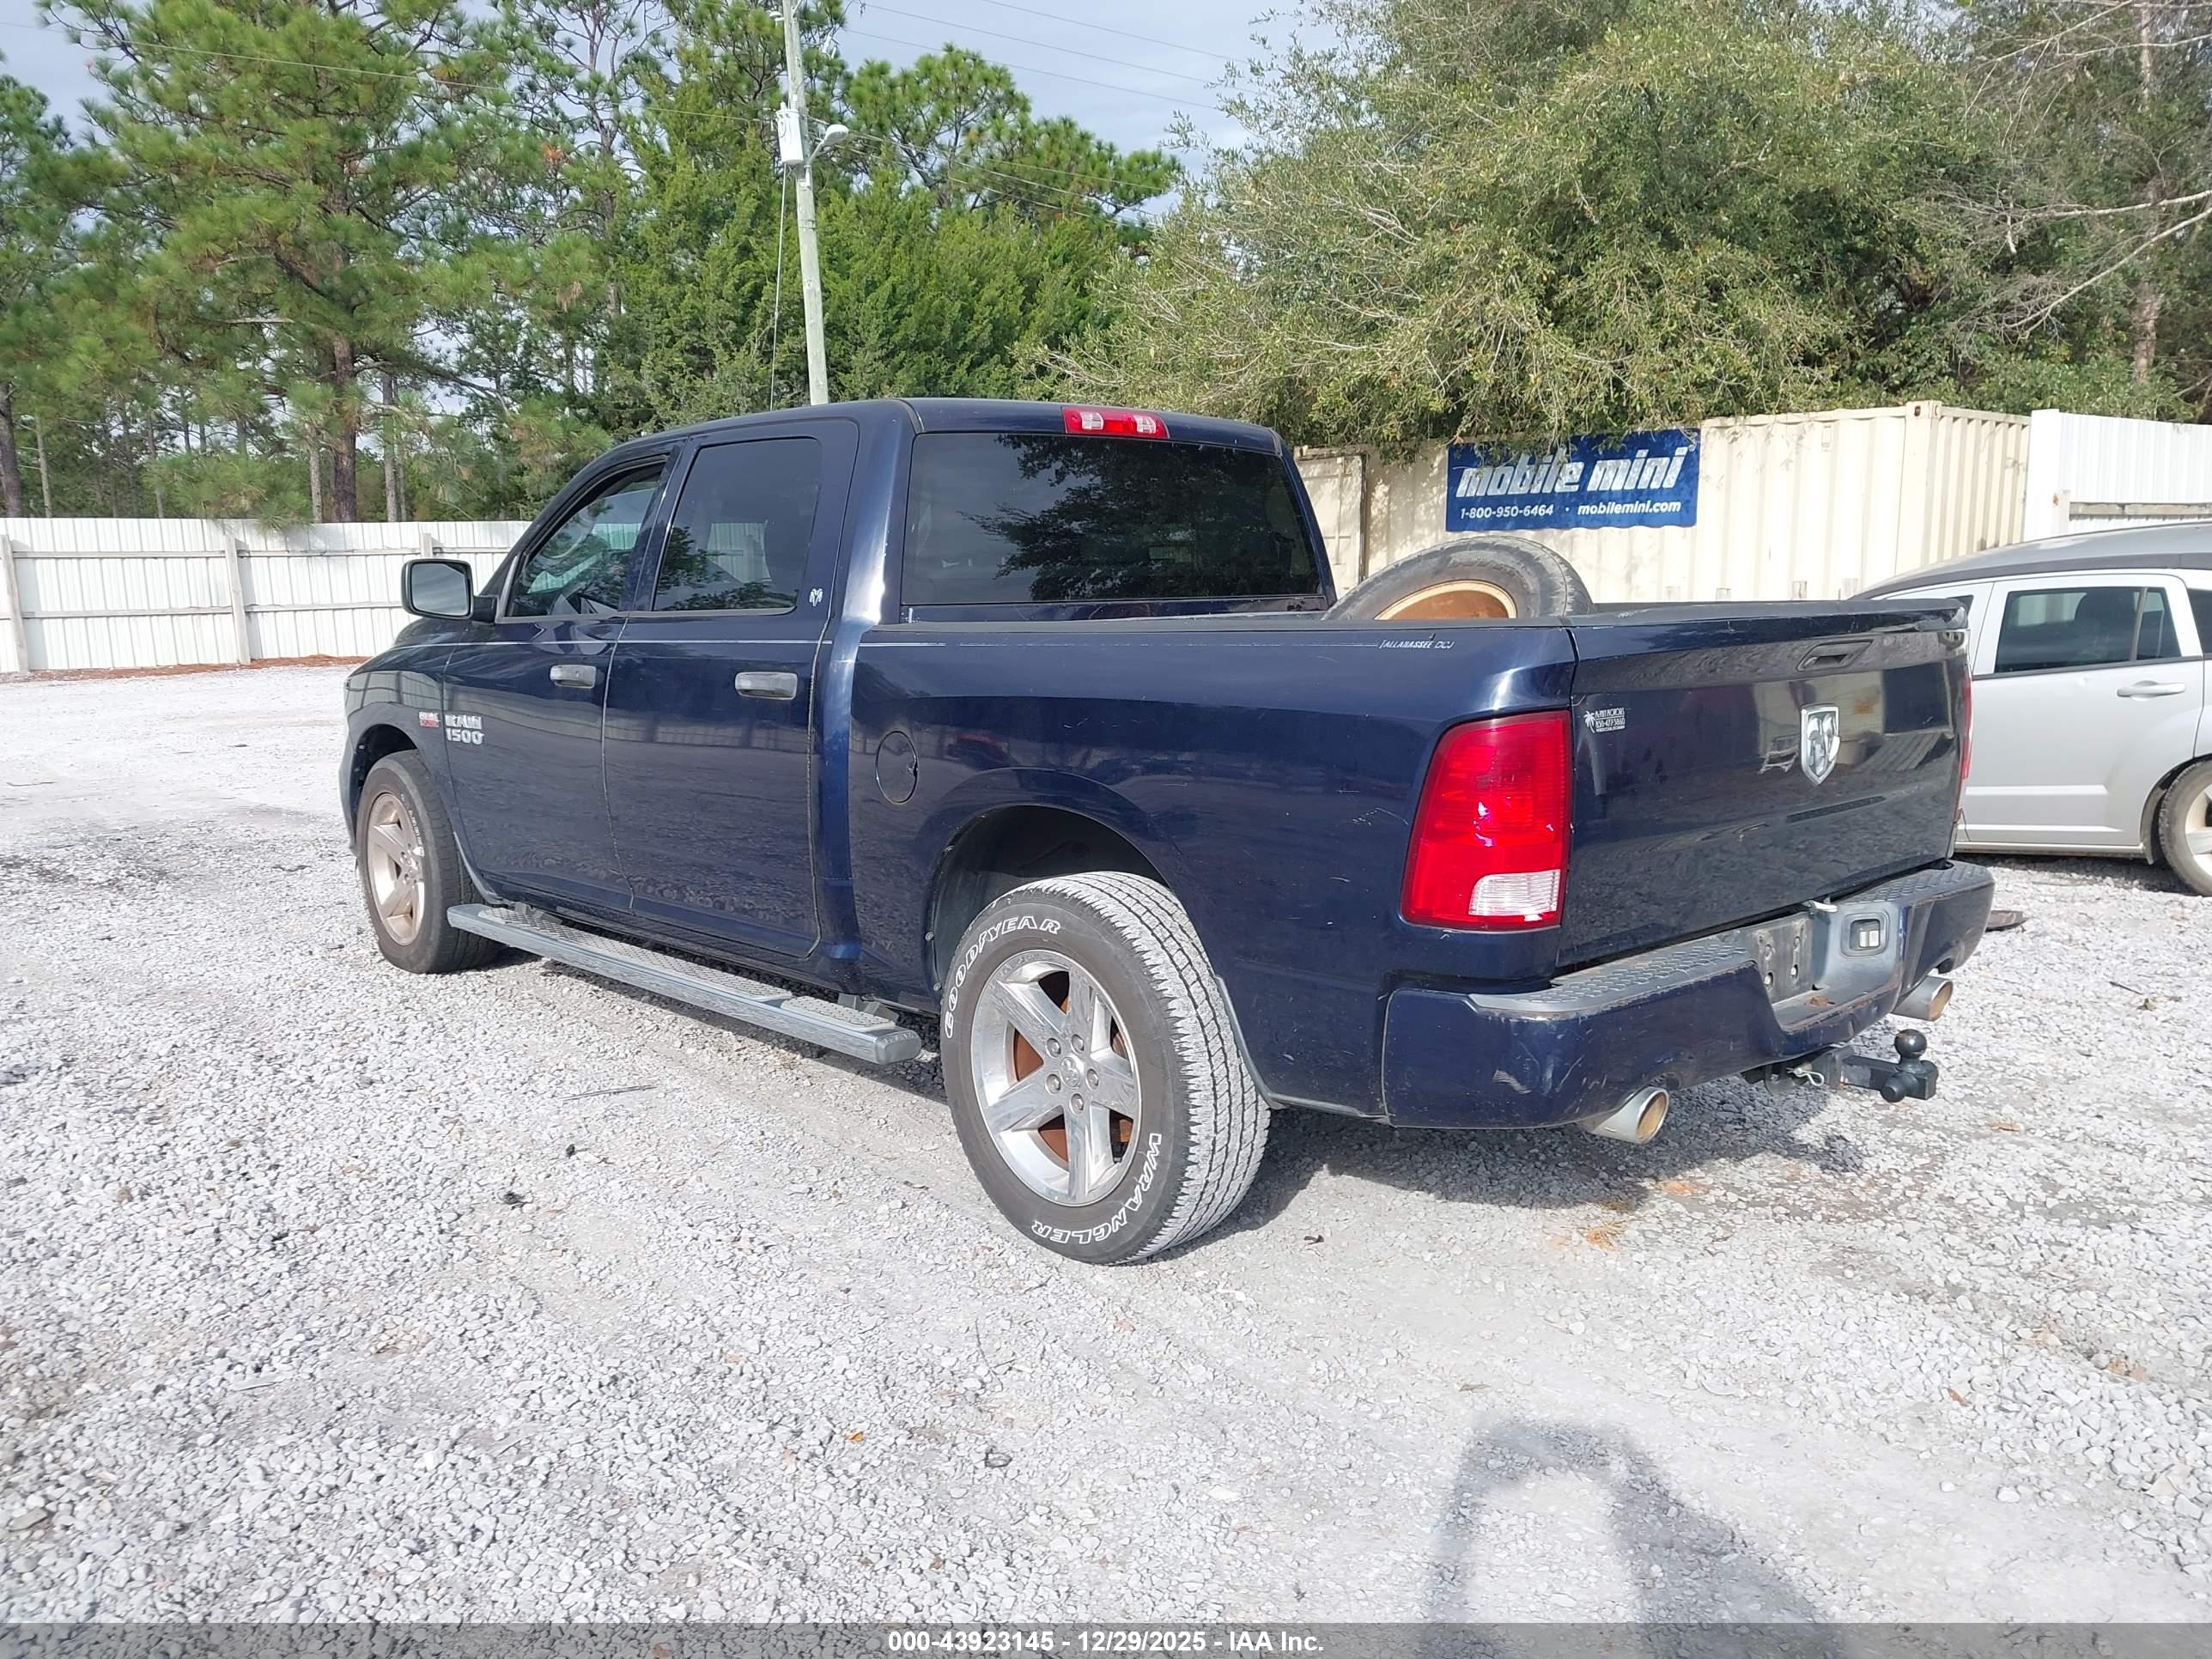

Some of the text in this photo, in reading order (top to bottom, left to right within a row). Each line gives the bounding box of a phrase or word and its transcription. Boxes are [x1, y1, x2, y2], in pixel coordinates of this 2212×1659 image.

[1455, 446, 1689, 497] mobile mini
[1460, 499, 1681, 520] 1-800-950-6464 mobilemini.com
[446, 727, 484, 744] 1500
[945, 915, 1061, 1039] GOODYEAR
[1031, 1133, 1163, 1245] WRANGLER
